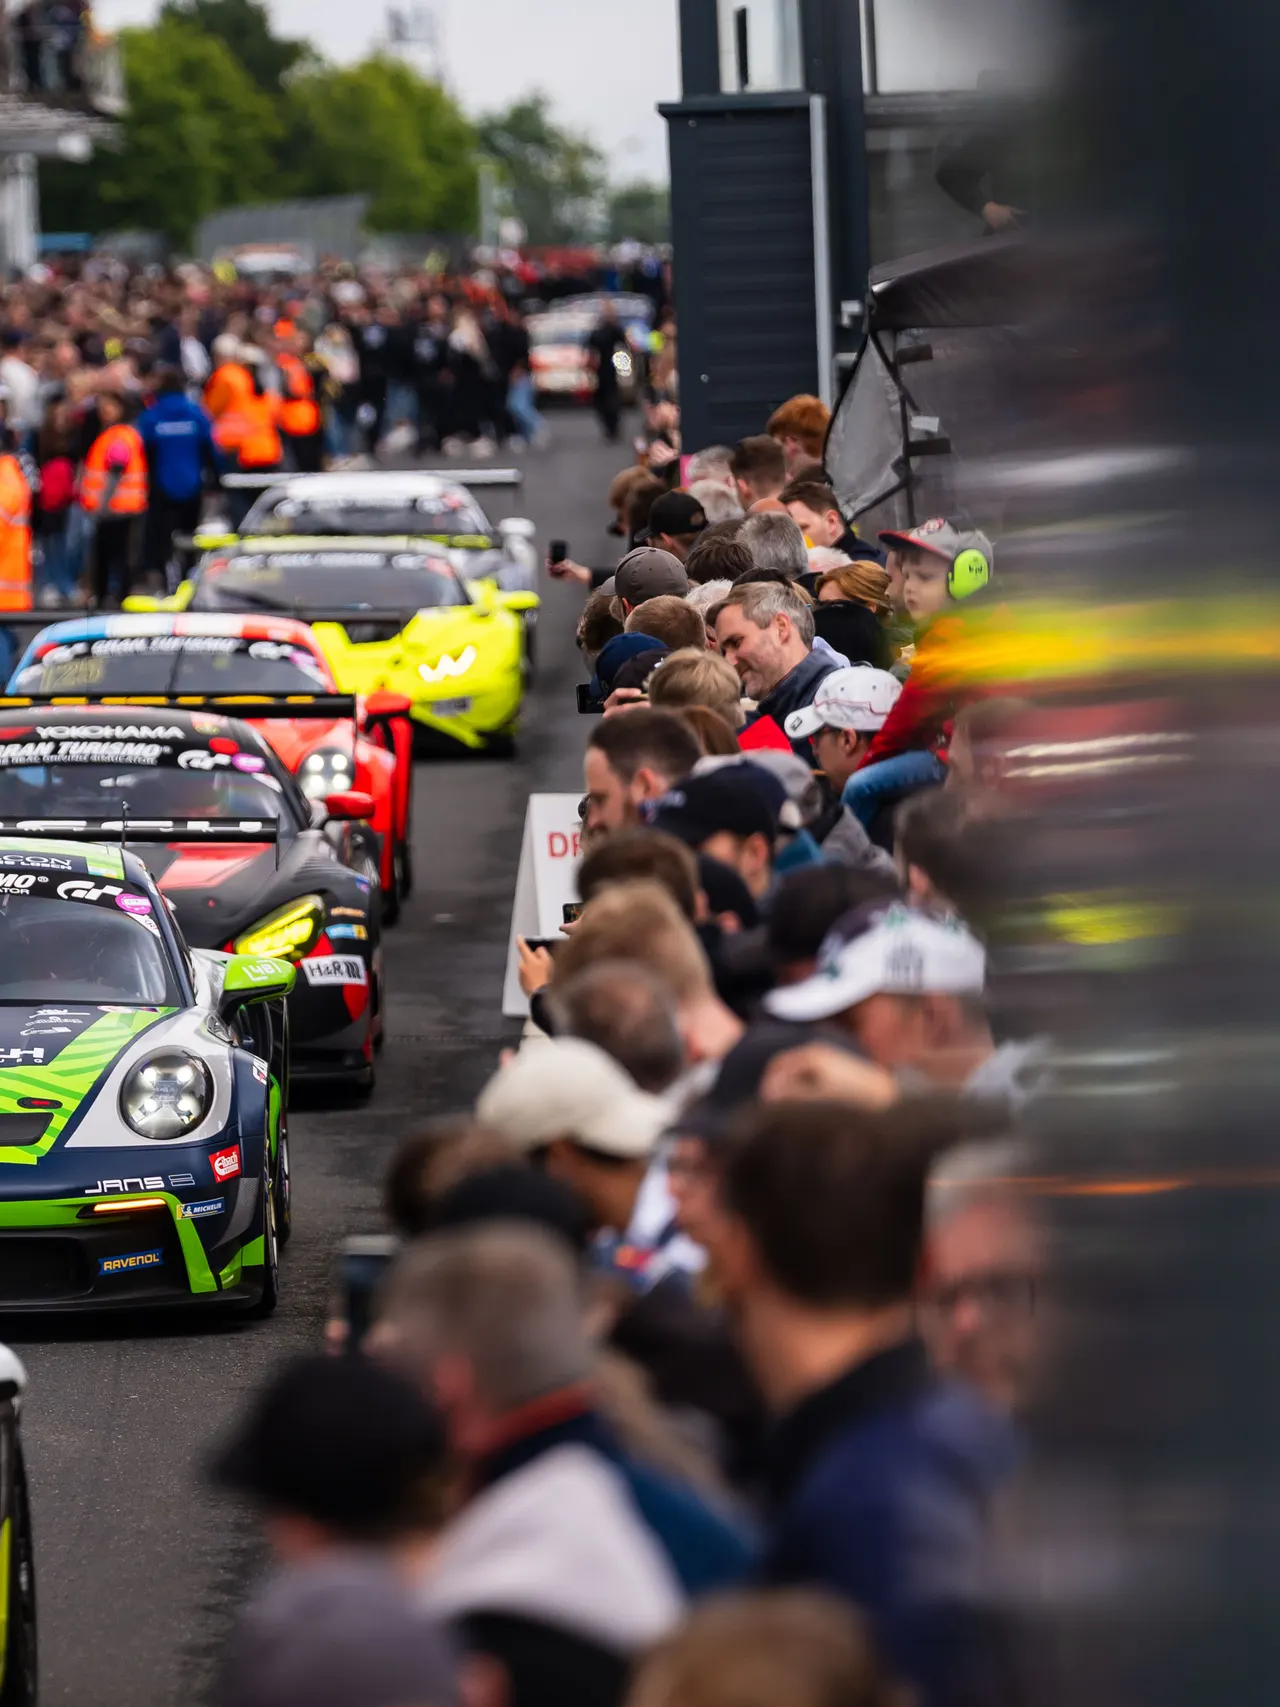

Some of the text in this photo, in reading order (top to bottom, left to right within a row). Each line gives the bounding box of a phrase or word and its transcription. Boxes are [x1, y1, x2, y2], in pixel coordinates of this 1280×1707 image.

[36, 725, 186, 740] YOKOHAMA
[57, 741, 162, 759] TURISMO
[85, 1176, 165, 1194] JANS
[193, 1202, 222, 1214] MICHELIN
[103, 1253, 160, 1271] RAVENOL
